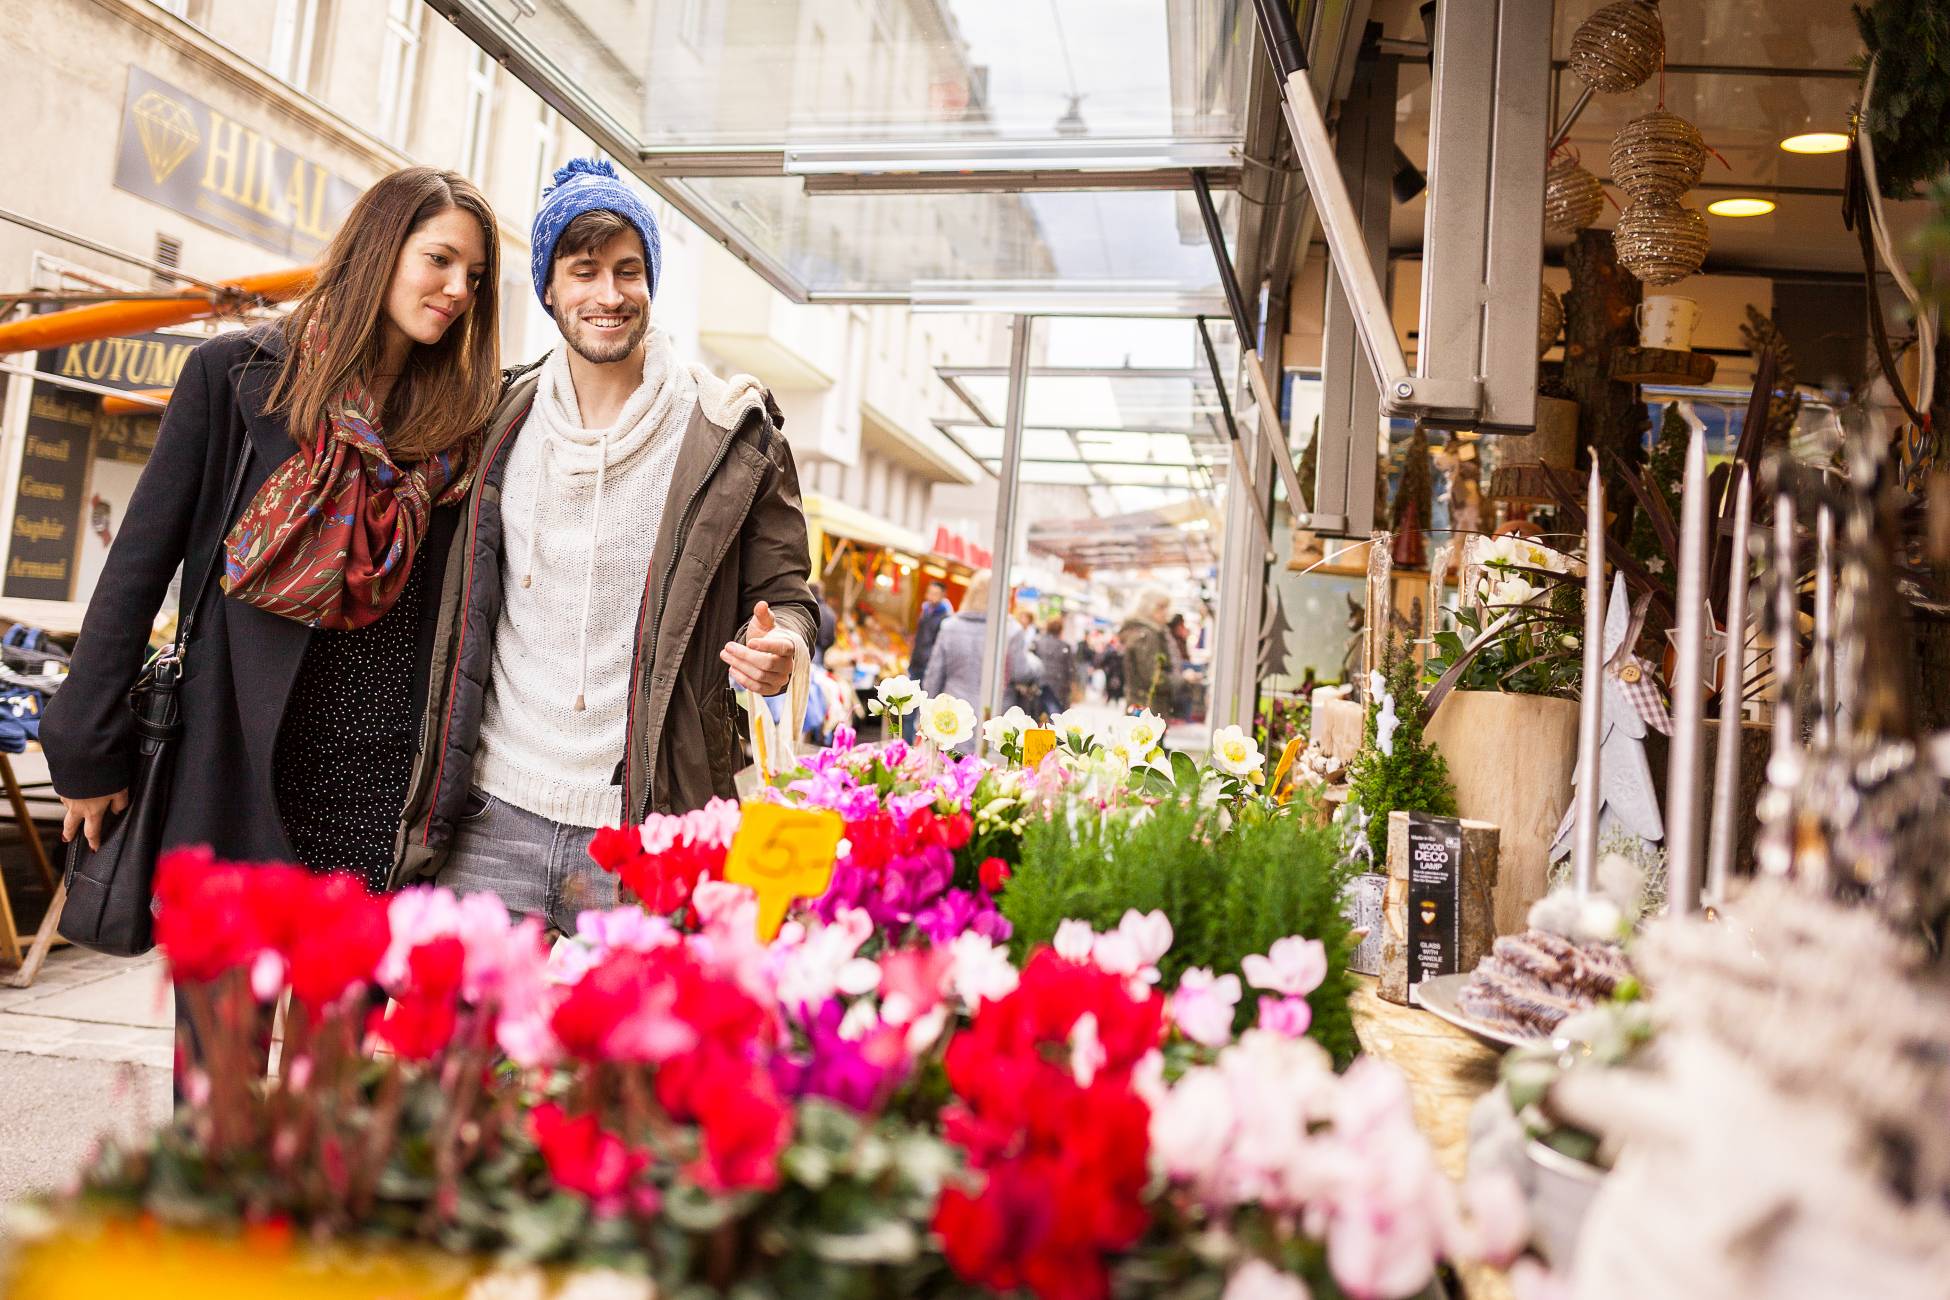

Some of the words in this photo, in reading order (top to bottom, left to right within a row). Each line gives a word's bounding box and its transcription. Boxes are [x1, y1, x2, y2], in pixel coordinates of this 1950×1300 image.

[201, 111, 334, 241] HILAL
[1418, 842, 1444, 851] WOOD
[1414, 850, 1449, 863] DECO
[1419, 862, 1443, 870] LAMP
[1420, 941, 1441, 950] GLASS
[1422, 948, 1439, 956] WITH
[1417, 954, 1443, 962] CANDLE
